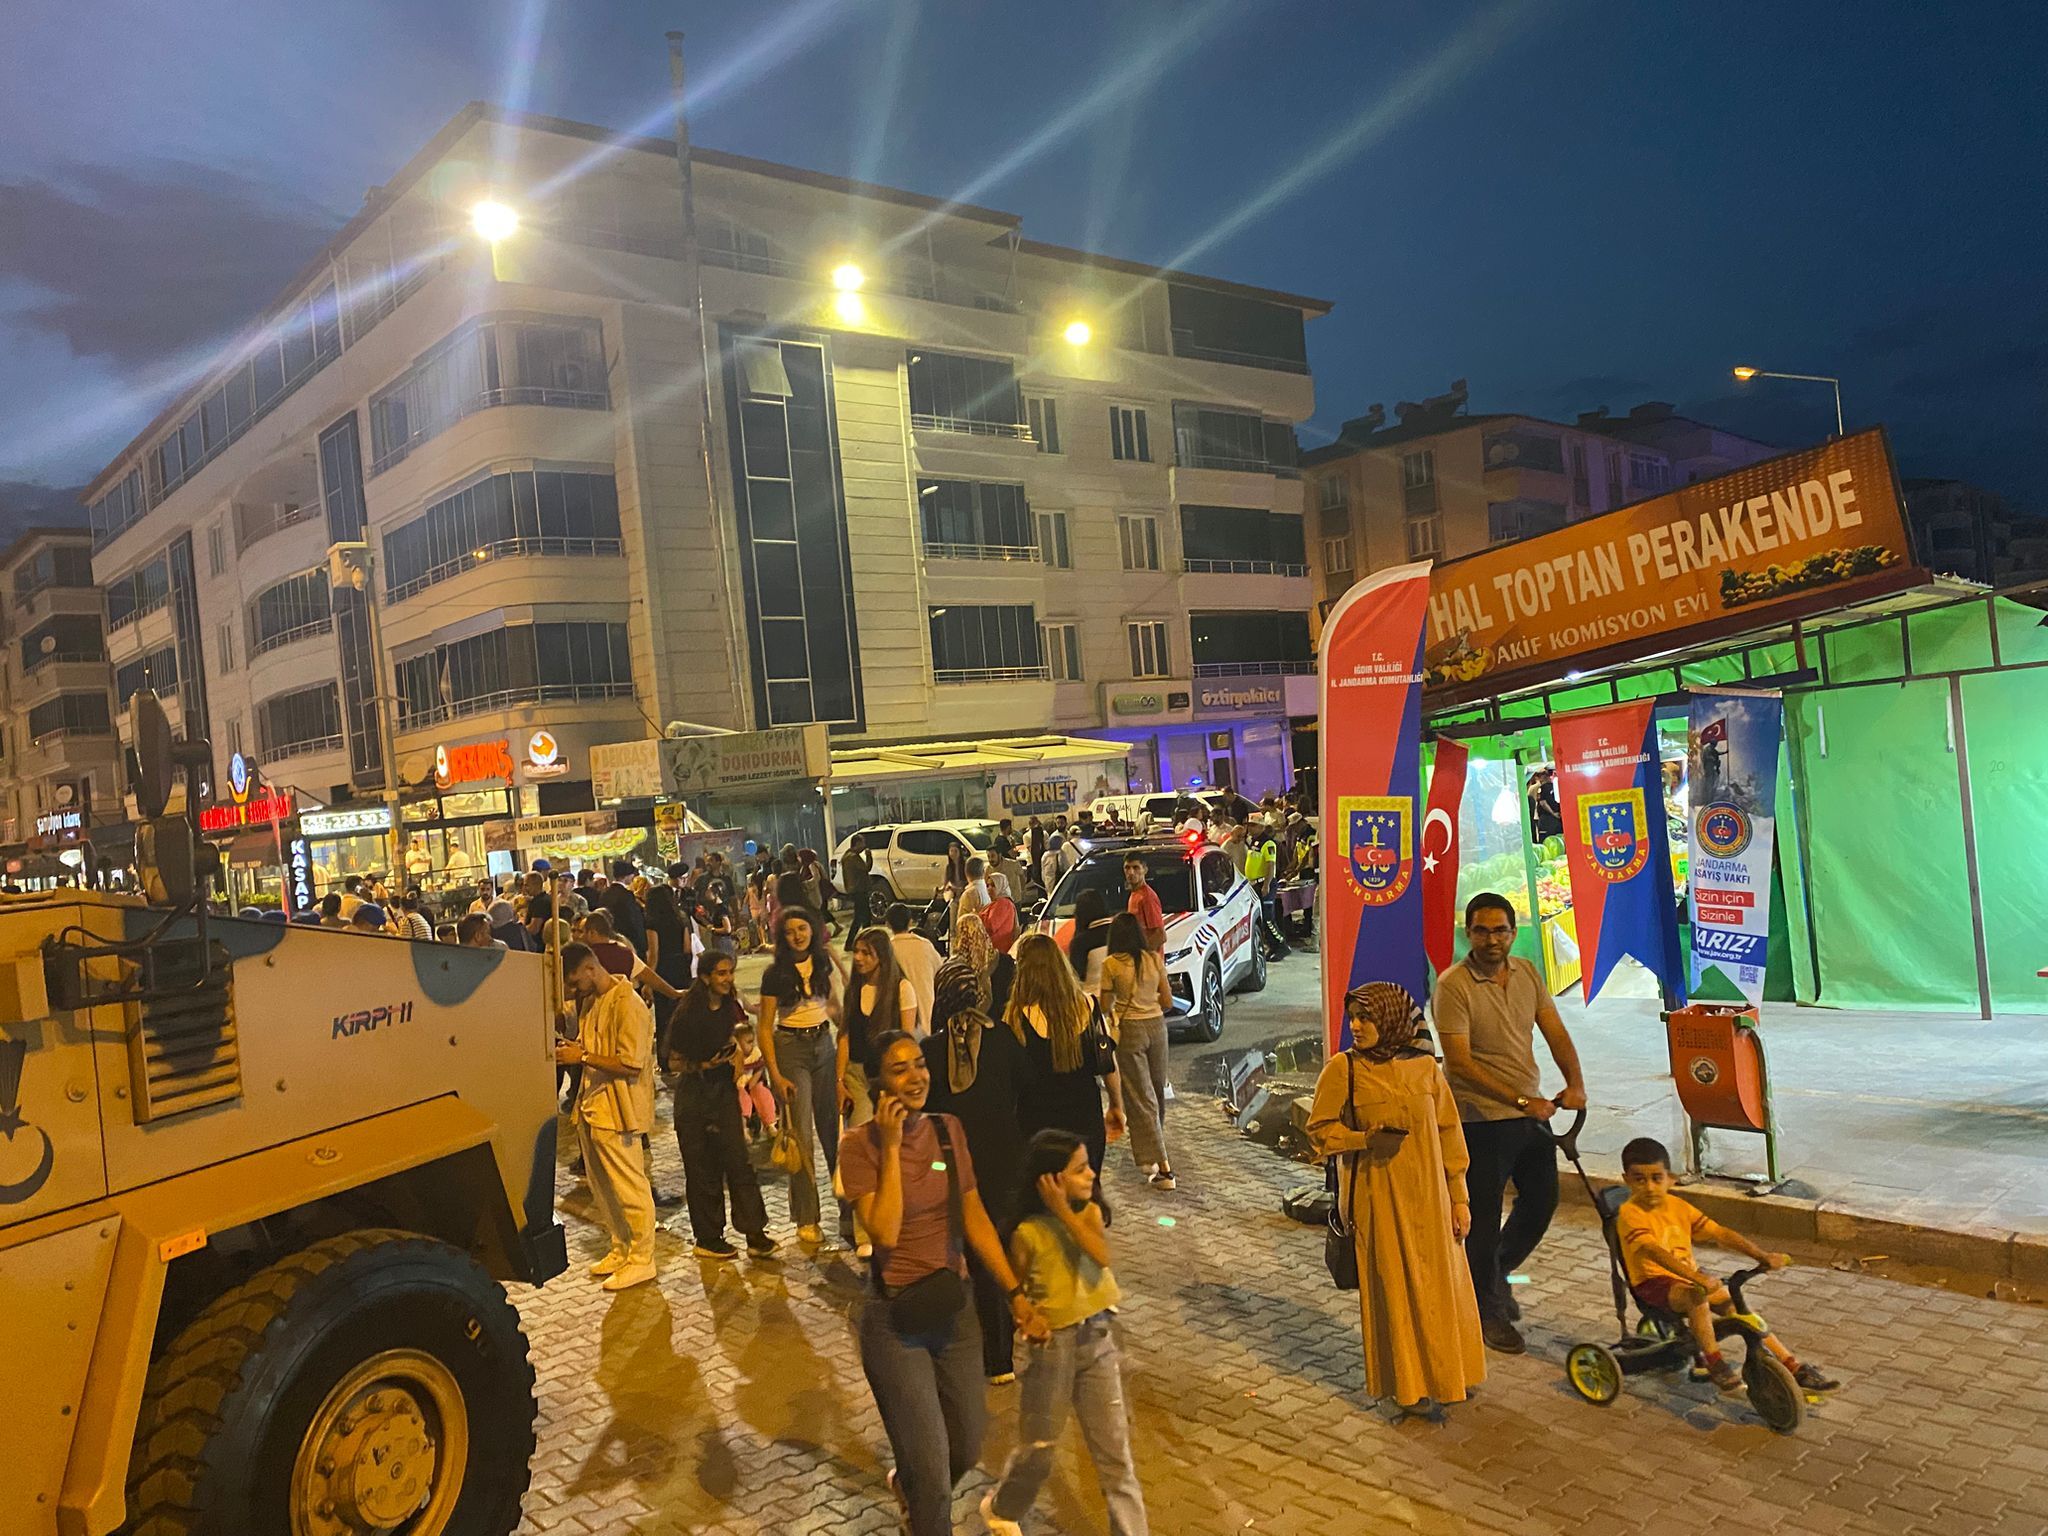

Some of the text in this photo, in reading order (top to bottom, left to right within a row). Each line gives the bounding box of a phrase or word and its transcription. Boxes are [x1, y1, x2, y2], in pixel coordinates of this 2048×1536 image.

[1430, 469, 1864, 642] HAL TOPTAN PERAKENDE
[1497, 587, 1710, 665] AKİF KOMİSYON EVİ
[1338, 676, 1378, 688] JANDARMA
[720, 749, 802, 772] DONDURMA
[1004, 781, 1076, 806] KORNET
[332, 814, 358, 828] 226
[359, 813, 378, 826] 30
[291, 840, 309, 909] KASAP
[1586, 849, 1646, 879] JANDARMA
[1696, 859, 1748, 873] JANDARMA
[1343, 867, 1409, 903] JANDARMA
[1724, 872, 1751, 884] VAKFI
[1695, 890, 1745, 905] Sizin için
[1700, 909, 1736, 922] Sizinle
